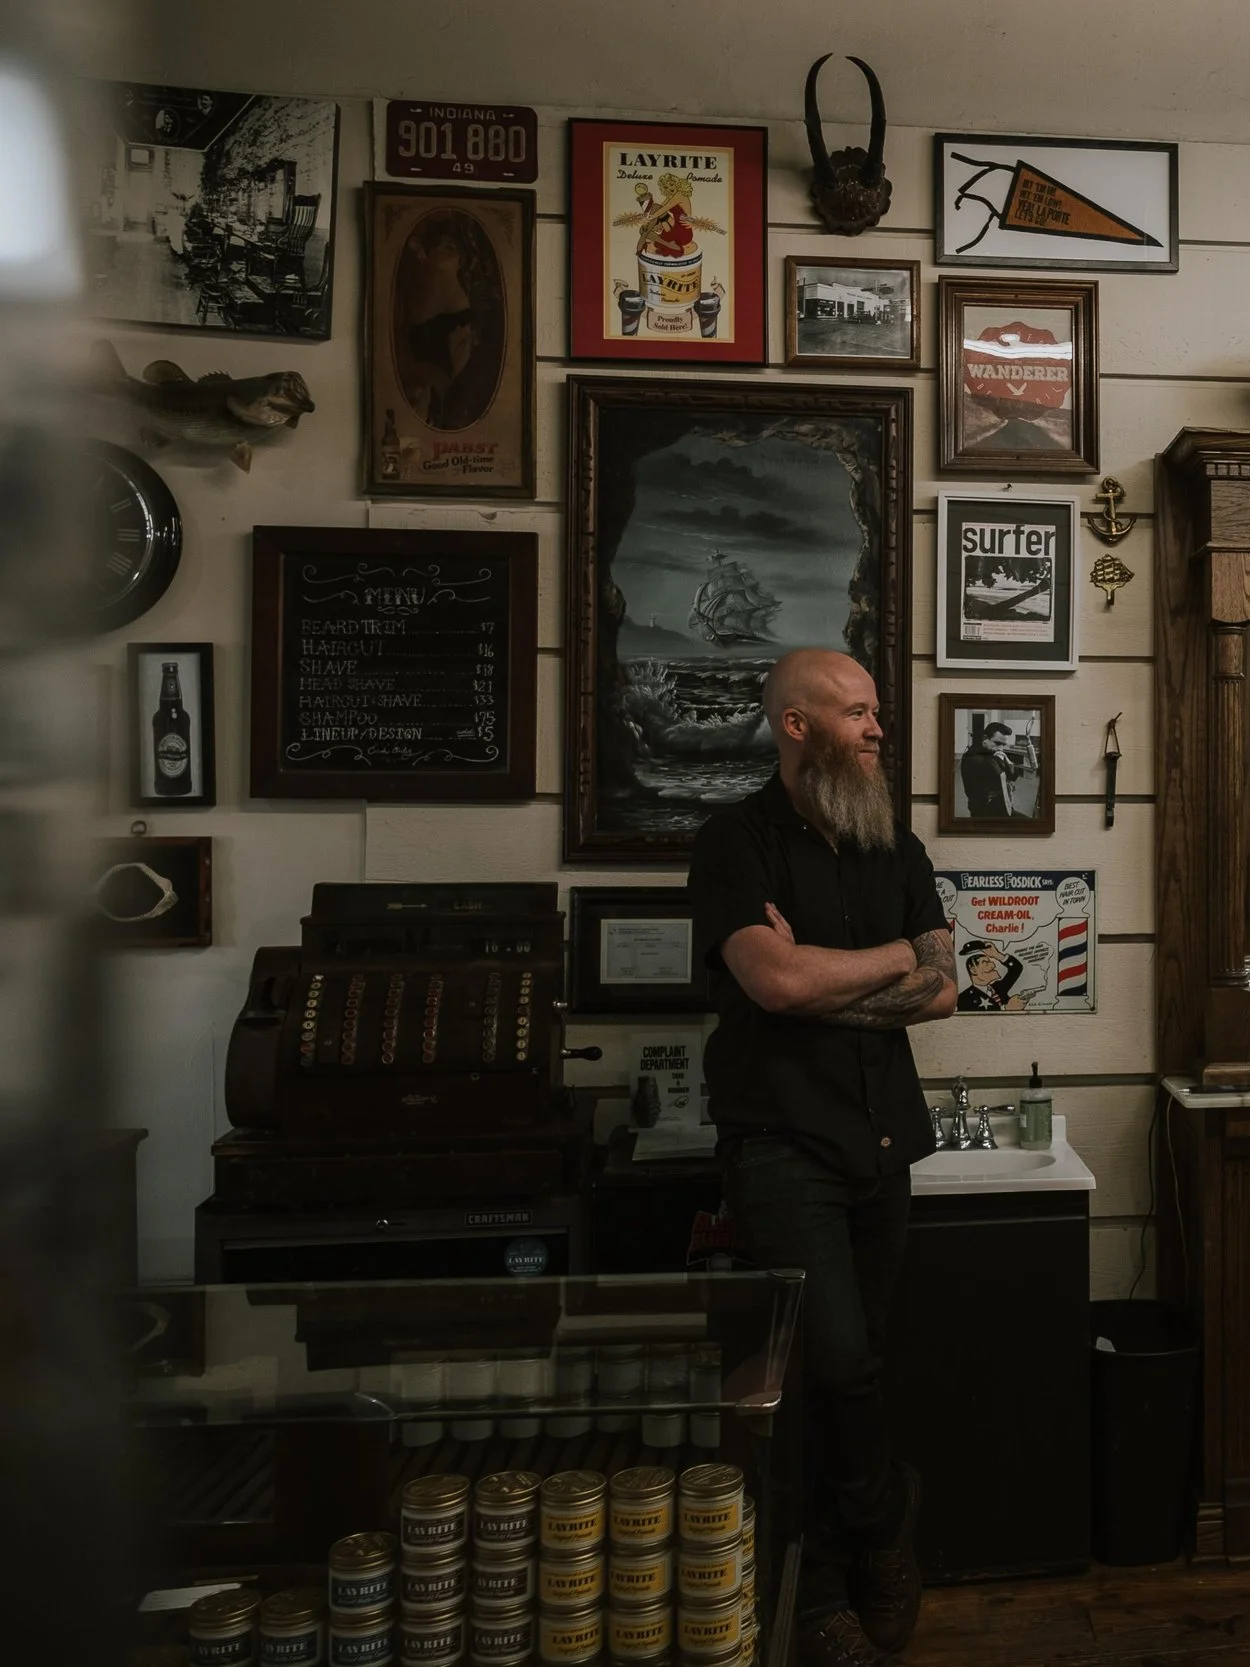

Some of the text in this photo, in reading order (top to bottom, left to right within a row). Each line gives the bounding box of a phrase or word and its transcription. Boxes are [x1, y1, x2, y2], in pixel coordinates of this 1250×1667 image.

[430, 107, 496, 121] INDIANA
[398, 120, 526, 163] 901 880
[452, 162, 475, 174] 49
[620, 152, 717, 170] LAYRITE
[616, 169, 723, 183] Deluxe Pomade
[1047, 208, 1071, 226] PORTE
[641, 272, 698, 293] LAYRITE
[653, 322, 688, 331] Sold Here!
[657, 315, 684, 324] Proudly
[967, 363, 1069, 381] WANDERER
[433, 441, 499, 460] PABST
[422, 455, 494, 471] Good Old-time
[462, 465, 494, 474] Flavor
[962, 525, 1057, 556] surfer
[364, 586, 426, 605] MENU
[301, 619, 360, 635] BEARD
[360, 619, 406, 635] TRIM
[302, 639, 385, 656] HAIRCUT
[299, 658, 358, 675] SHAVE
[299, 677, 343, 691] HEAD
[347, 678, 396, 691] SHAVE
[299, 709, 378, 726] SHAMPOO
[960, 873, 1004, 890] FEARLESS
[1004, 873, 1042, 890] FOSDICK
[1064, 880, 1080, 890] BEST
[1059, 887, 1086, 899] HAIR CUT
[453, 900, 483, 912] CASH
[971, 896, 1041, 907] Get WILDROOT
[1062, 895, 1086, 906] IN TOWN
[977, 910, 1035, 921] CREAM-OIL,
[643, 1045, 686, 1058] COMPLAINT
[640, 1058, 690, 1071] DEPARTMENT
[468, 1212, 530, 1225] CRAFTSMAN
[508, 1256, 543, 1264] LAYRITE
[480, 1519, 529, 1531] LAYRITE
[548, 1518, 596, 1532] LAYRITE
[614, 1515, 661, 1527] LAYRITE
[684, 1512, 730, 1524] LAYRITE
[407, 1521, 457, 1535] LAYRITE
[610, 1571, 656, 1584] LAYRITE
[681, 1567, 728, 1580] LAYRITE
[407, 1579, 456, 1592] LAYRITE
[548, 1574, 595, 1588] LAYRITE
[337, 1581, 388, 1596] LAYRITE
[552, 1627, 599, 1645] LAYRITE
[616, 1624, 664, 1639] LAYRITE
[684, 1622, 731, 1636] LAYRITE
[338, 1637, 389, 1654] LAYRITE
[404, 1636, 452, 1649] LAYRITE
